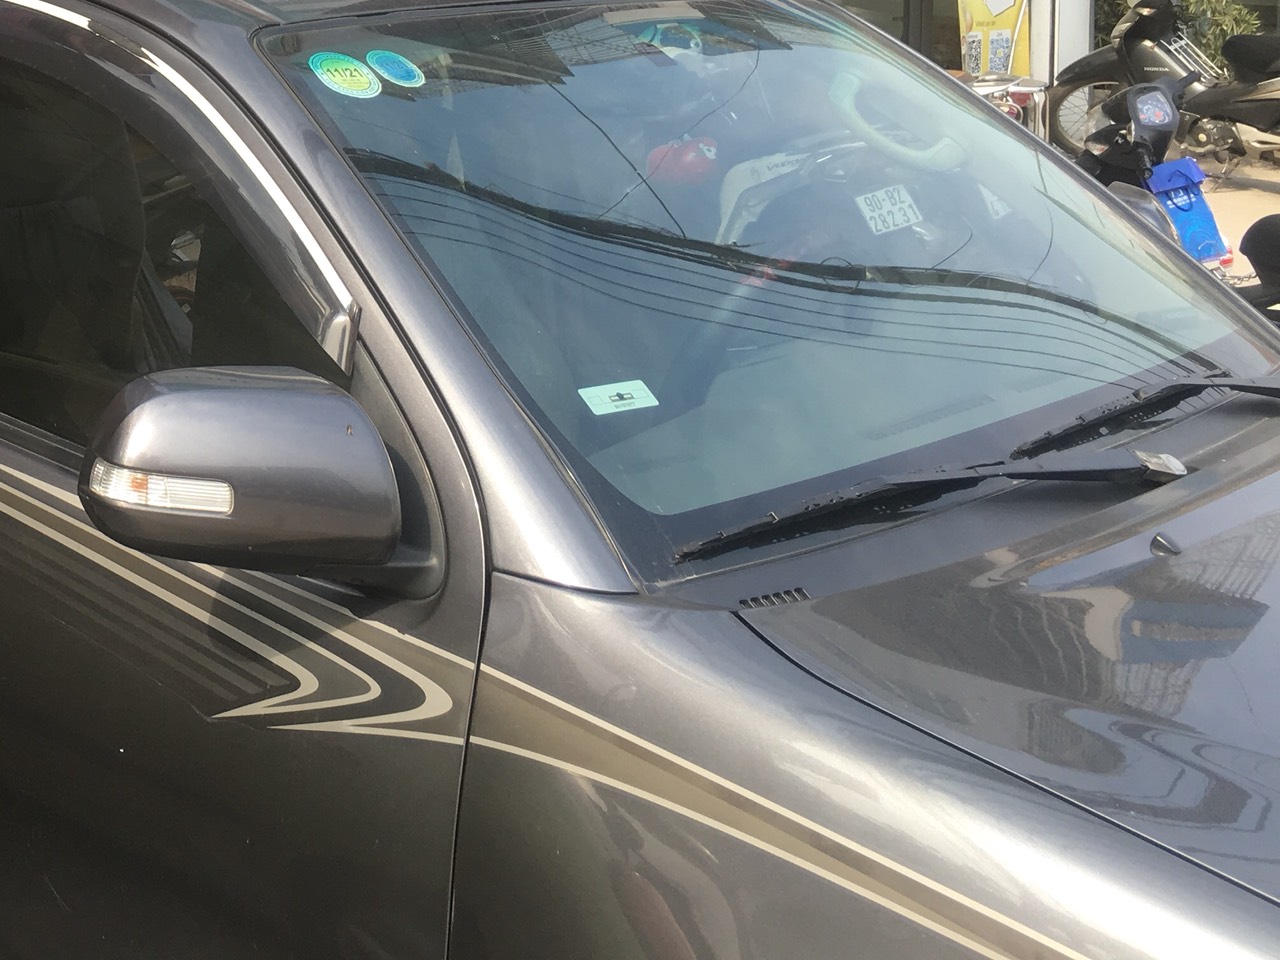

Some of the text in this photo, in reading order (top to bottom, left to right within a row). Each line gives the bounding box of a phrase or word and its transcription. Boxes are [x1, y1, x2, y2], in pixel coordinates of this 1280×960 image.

[326, 67, 364, 79] 11/21
[863, 187, 906, 214] 90-B2
[869, 203, 920, 234] 282.31
